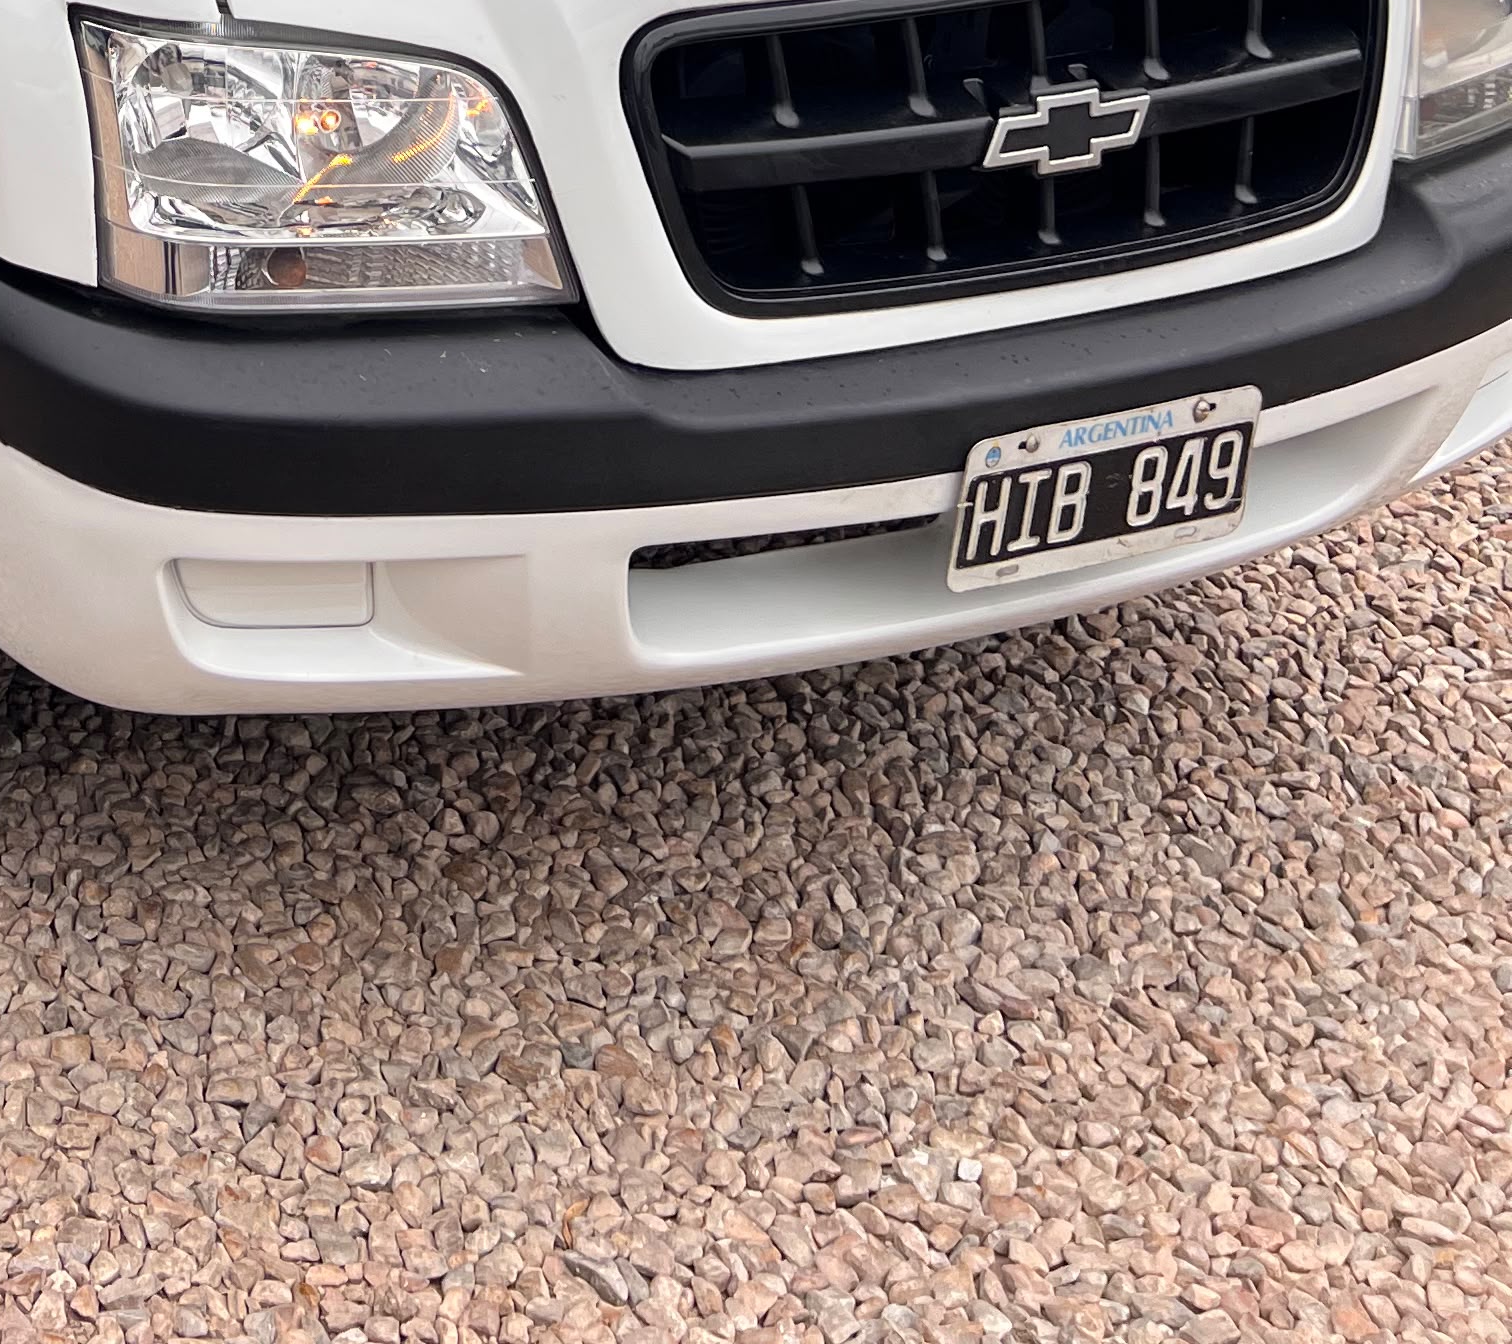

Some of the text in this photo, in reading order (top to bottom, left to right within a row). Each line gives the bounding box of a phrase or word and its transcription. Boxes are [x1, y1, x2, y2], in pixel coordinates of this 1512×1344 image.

[1059, 409, 1174, 449] ARGENTINA
[966, 430, 1244, 561] HIB 849
